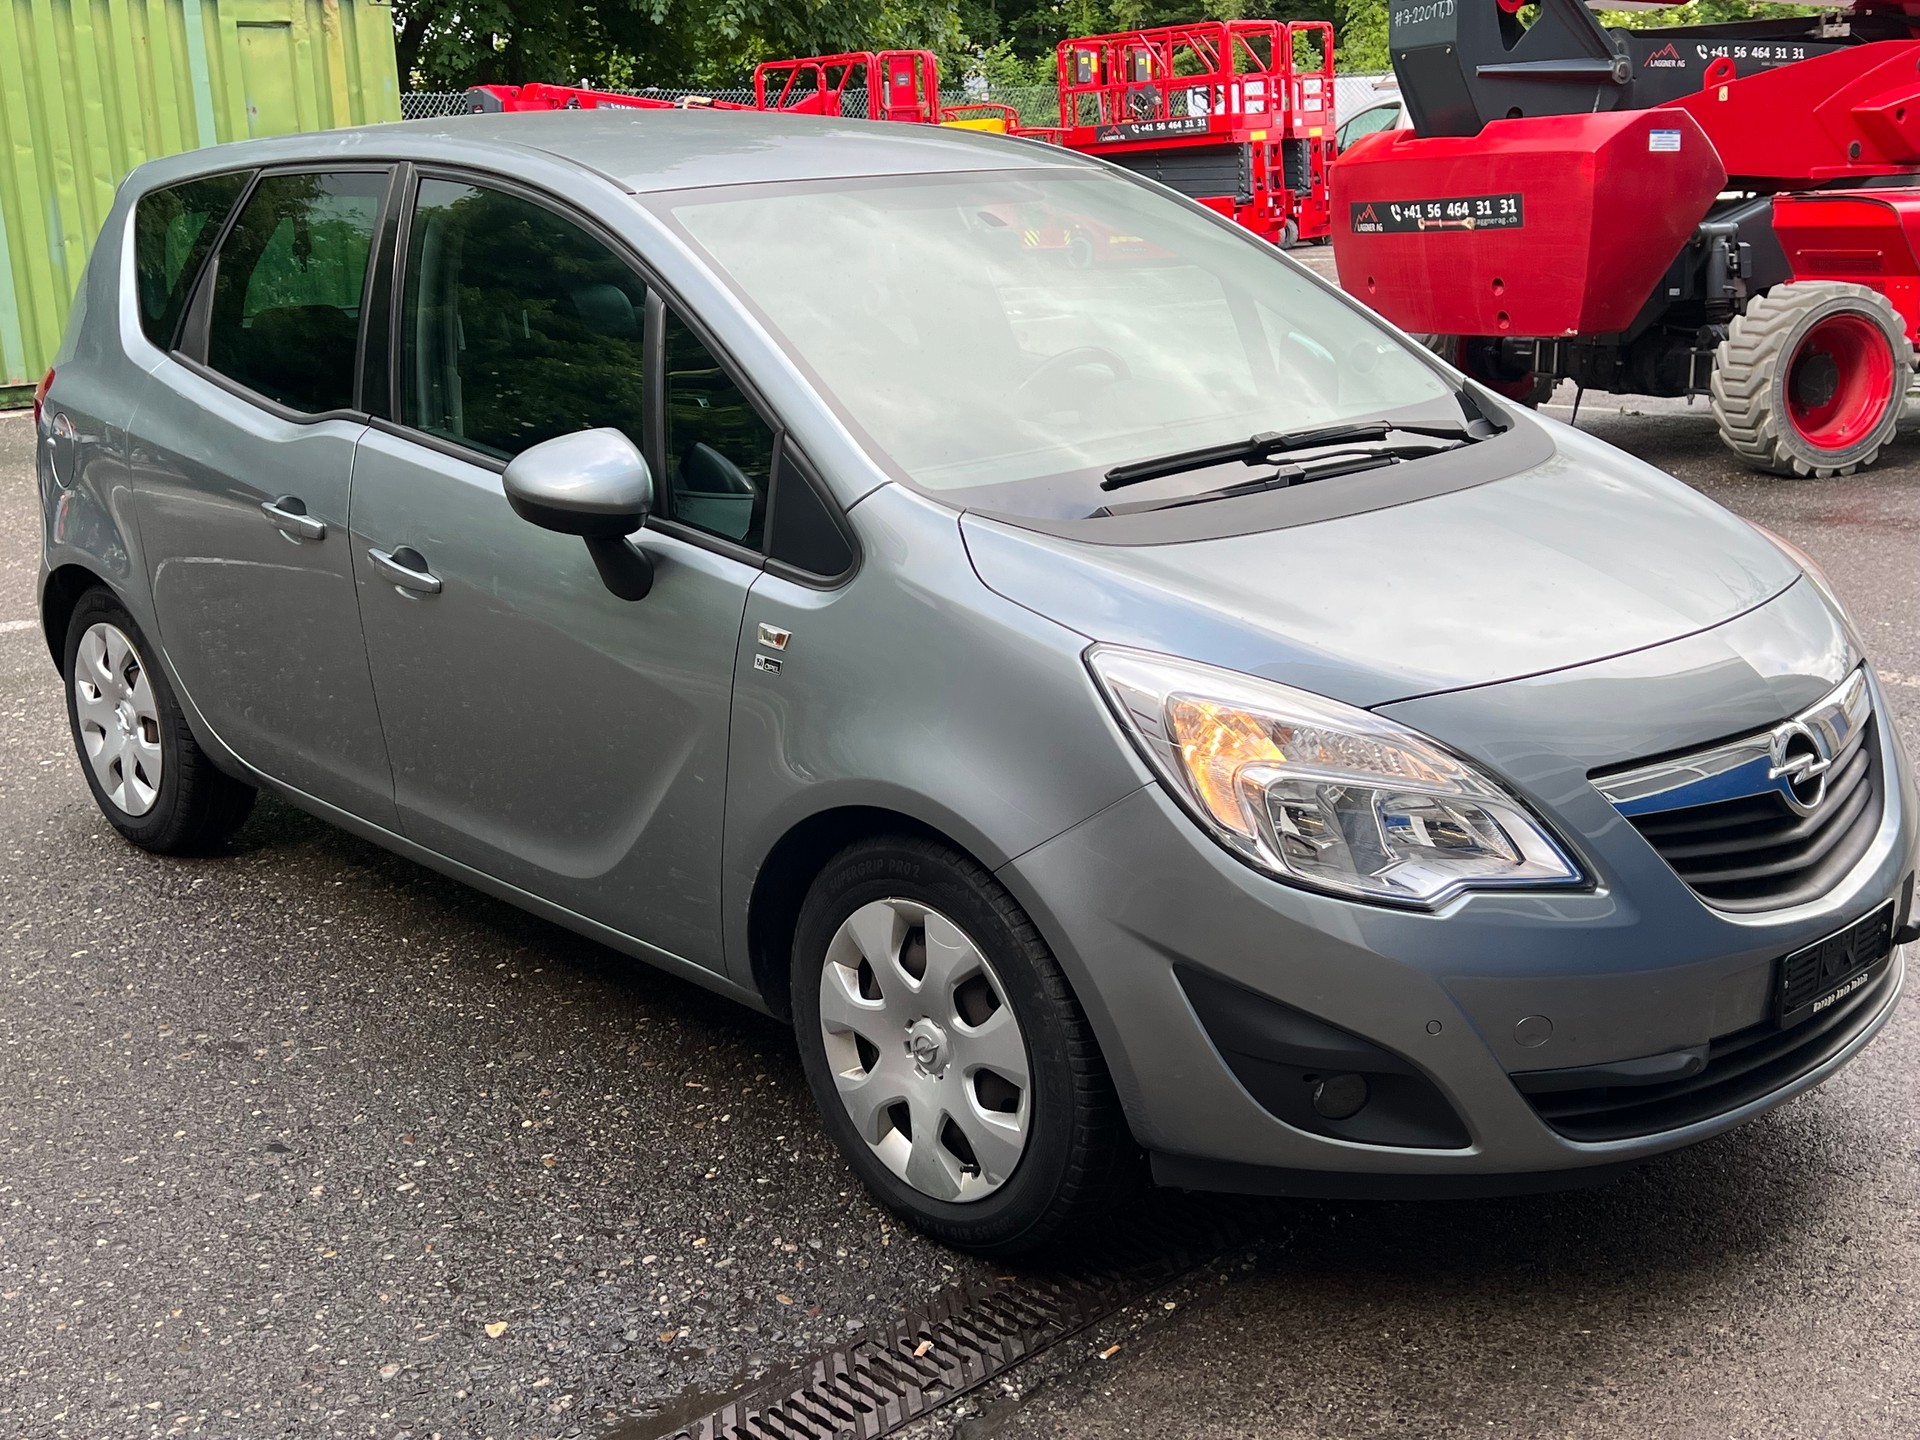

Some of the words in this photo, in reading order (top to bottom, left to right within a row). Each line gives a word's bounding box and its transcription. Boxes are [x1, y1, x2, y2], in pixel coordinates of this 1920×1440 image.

[1710, 46, 1729, 58] +41
[1734, 46, 1747, 58] 56
[1751, 46, 1770, 59] 464
[1775, 47, 1787, 59] 31
[1792, 47, 1805, 59] 31
[1677, 59, 1686, 68] AG
[1140, 123, 1153, 131] +41
[1156, 122, 1165, 131] 56
[1168, 121, 1182, 129] 464
[1184, 119, 1194, 128] 31
[1197, 118, 1206, 127] 31
[1403, 204, 1422, 219] +41
[1427, 203, 1441, 218] 56
[1447, 201, 1469, 216] 464
[1476, 200, 1492, 215] 31
[1500, 198, 1517, 213] 31
